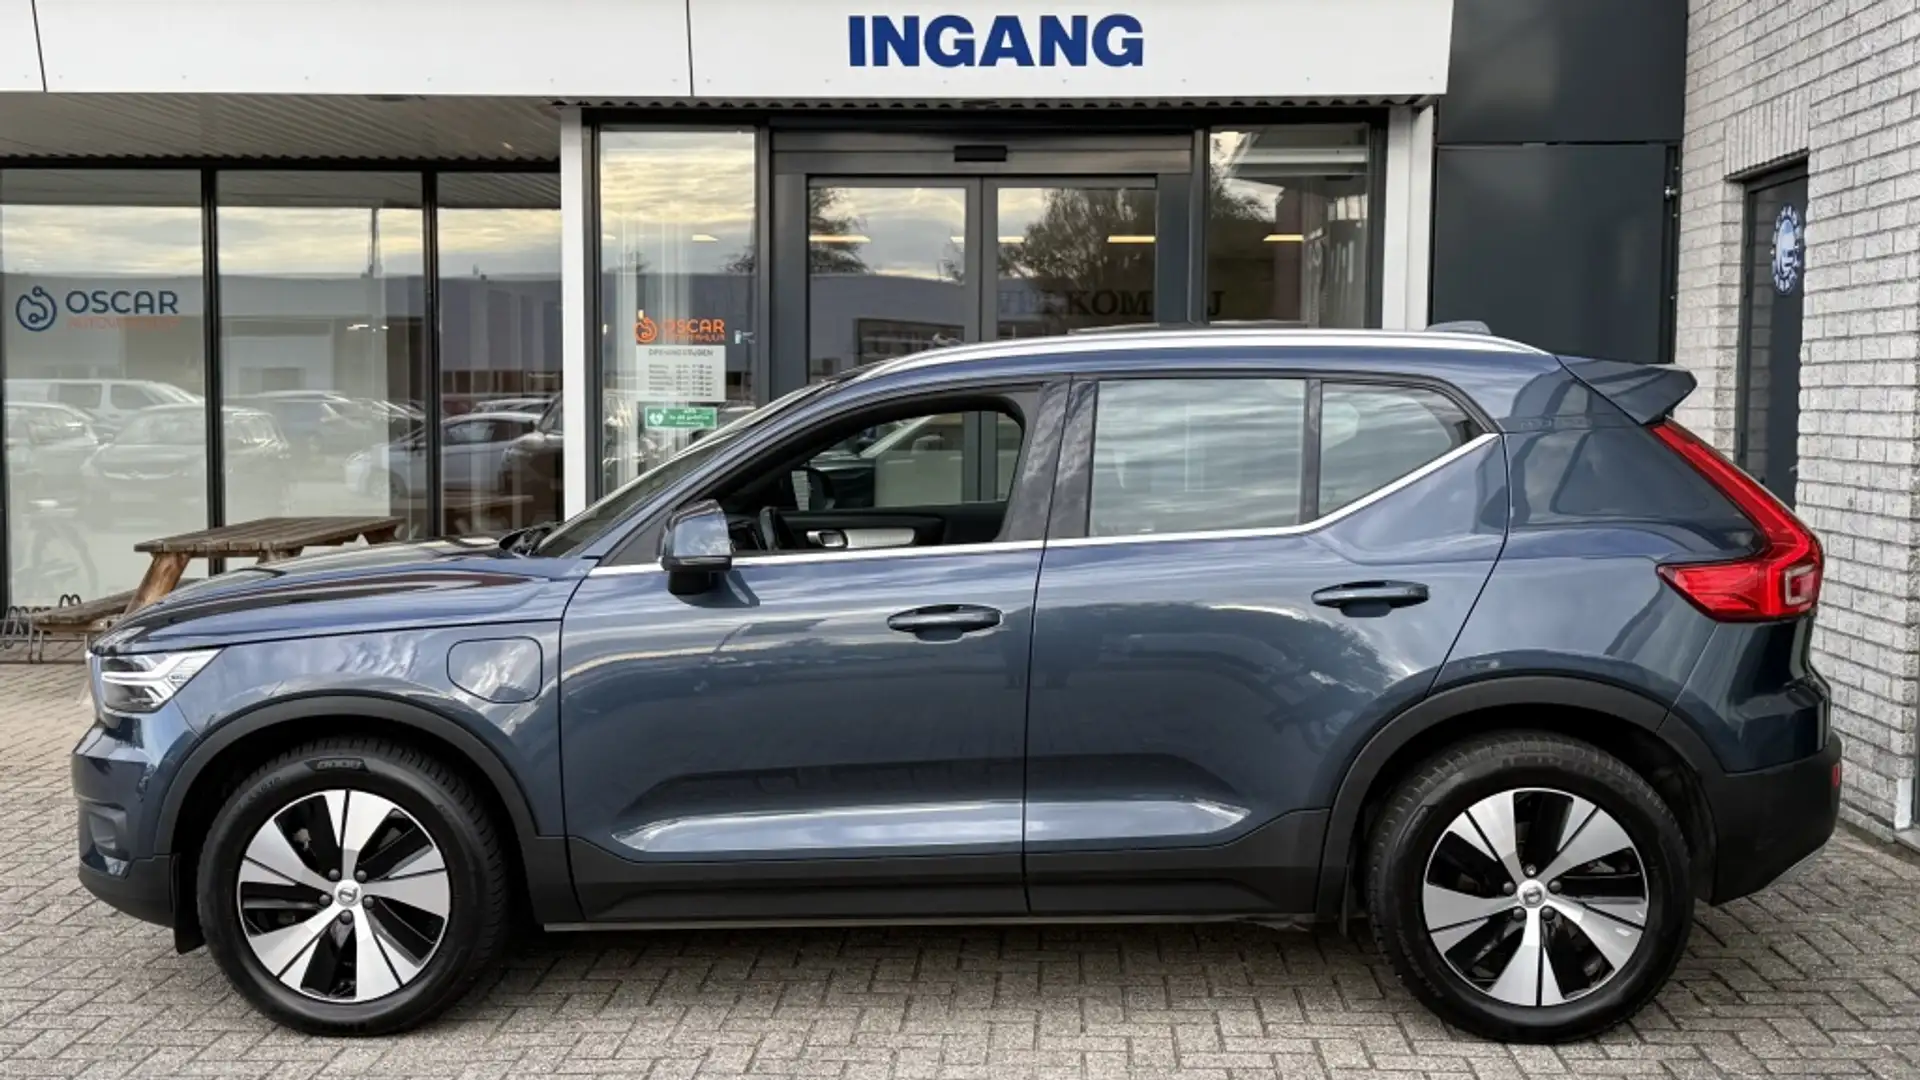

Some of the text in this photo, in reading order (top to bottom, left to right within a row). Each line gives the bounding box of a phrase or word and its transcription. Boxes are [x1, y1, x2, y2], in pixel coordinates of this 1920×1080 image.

[848, 14, 1144, 68] INGANG
[65, 290, 179, 314] OSCAR
[663, 318, 725, 333] OSCAR
